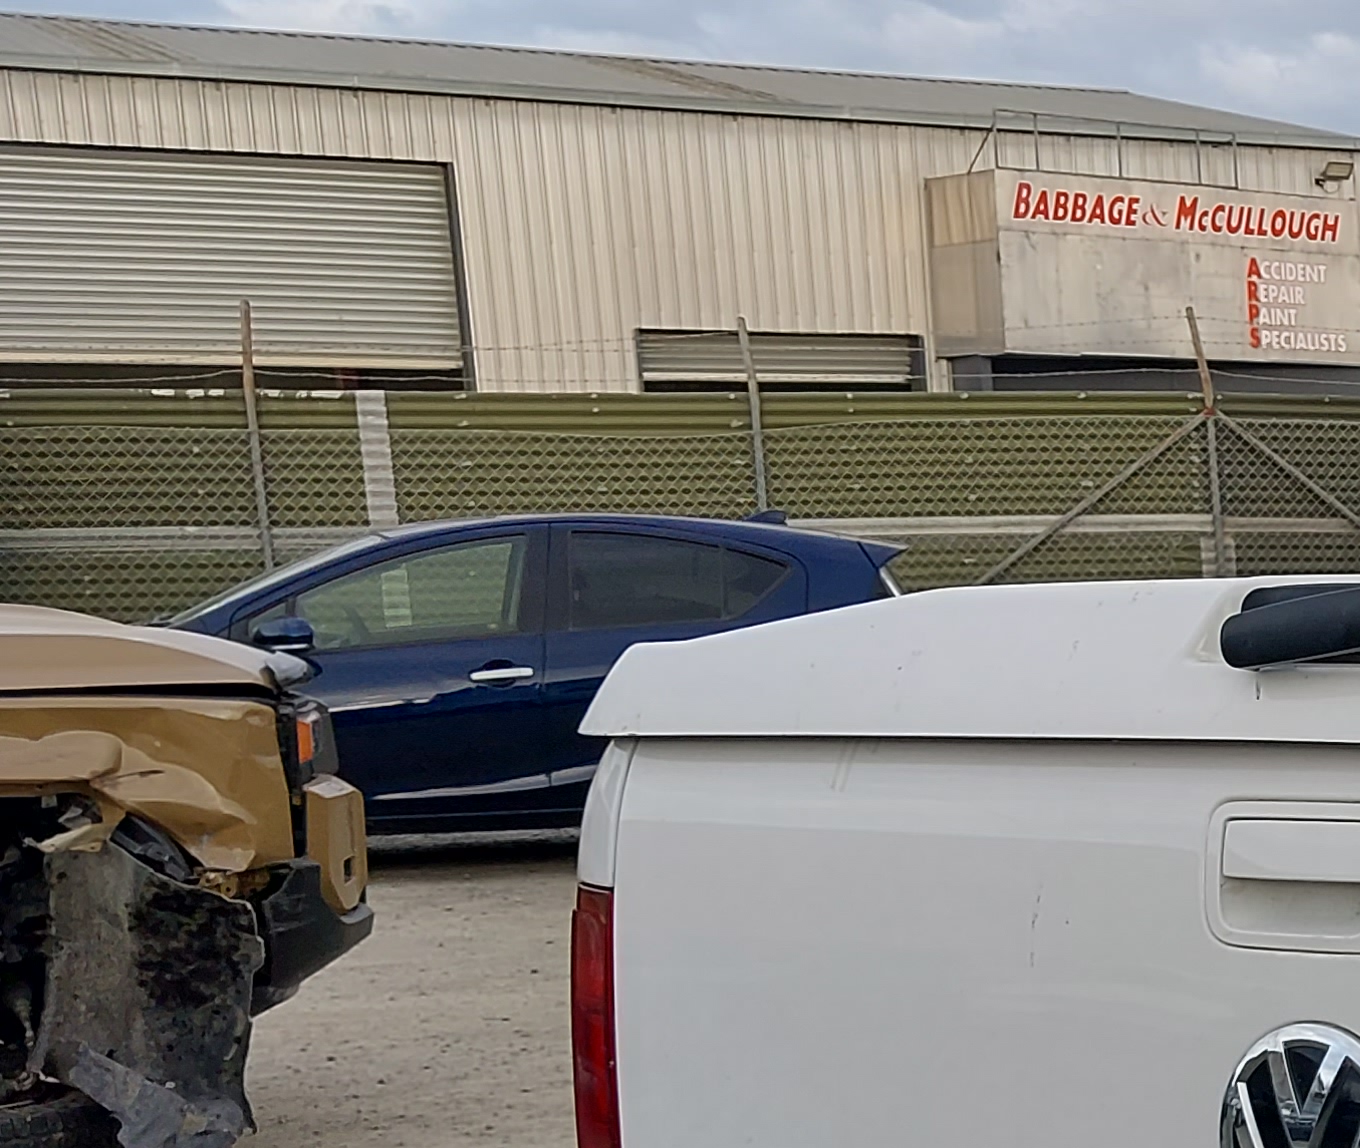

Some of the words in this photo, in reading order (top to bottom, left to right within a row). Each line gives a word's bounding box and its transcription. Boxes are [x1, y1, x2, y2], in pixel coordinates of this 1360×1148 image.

[1013, 182, 1140, 227] BABBAGE
[1174, 196, 1341, 243] McCULLOUGH
[1247, 257, 1326, 284] ACCIDENT
[1247, 280, 1305, 306] REPAIR
[1247, 303, 1297, 328] PAINT
[1249, 327, 1347, 353] SPECIALISTS
